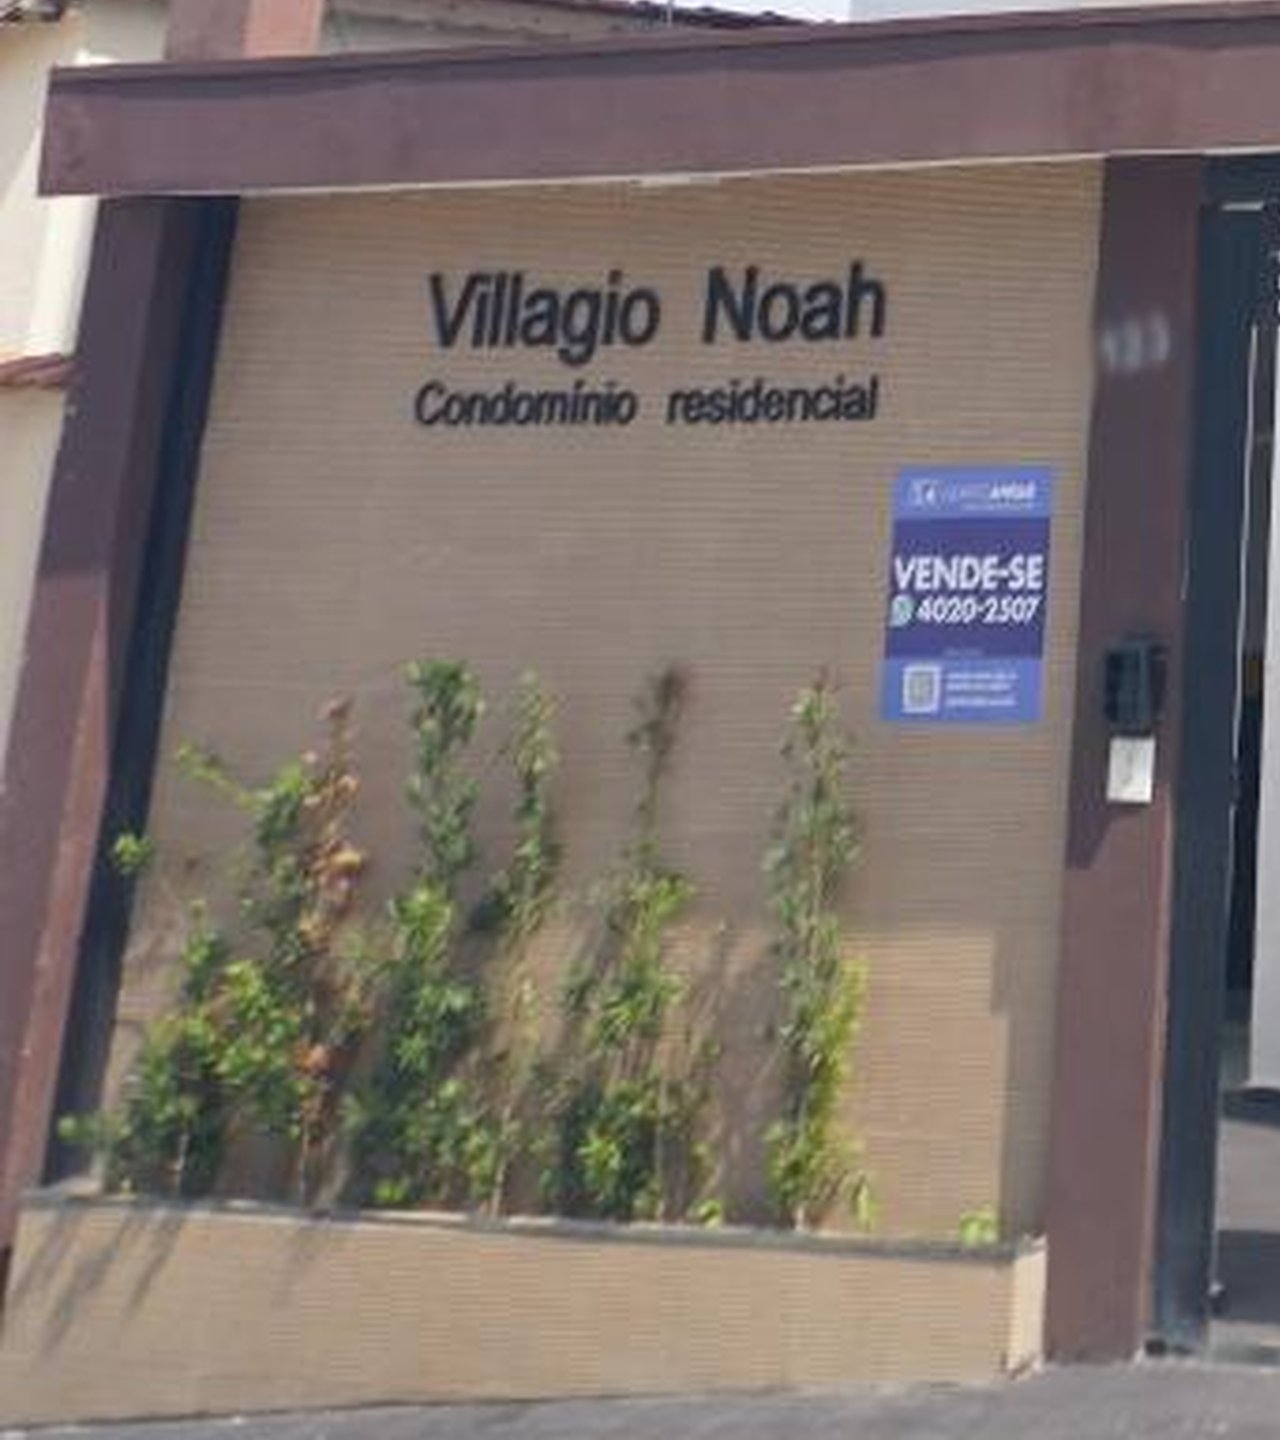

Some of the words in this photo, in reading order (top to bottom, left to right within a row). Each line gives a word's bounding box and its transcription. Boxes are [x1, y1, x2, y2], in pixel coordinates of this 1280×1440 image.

[428, 269, 661, 366] Villagio
[702, 258, 887, 344] Noah
[414, 380, 638, 427] Condomínio
[665, 374, 879, 424] residencial
[894, 555, 1044, 590] VENDE-SE
[917, 595, 1042, 624] 4020-2507
